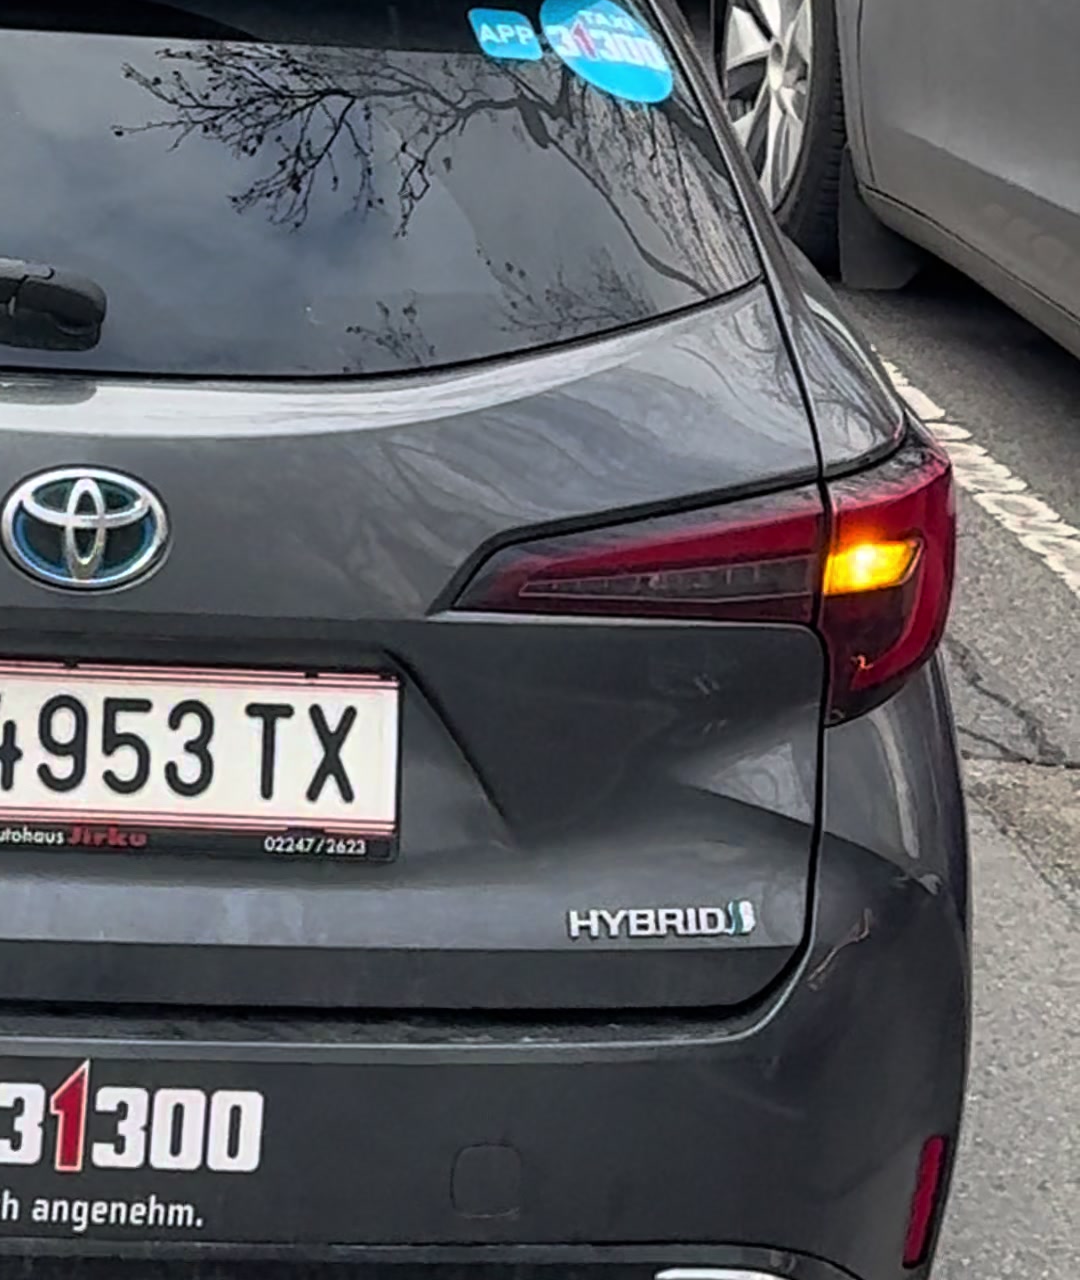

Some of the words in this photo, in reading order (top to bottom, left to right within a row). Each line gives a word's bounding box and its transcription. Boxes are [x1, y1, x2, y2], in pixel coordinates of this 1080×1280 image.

[479, 23, 534, 45] APP
[245, 702, 358, 802] TX
[70, 825, 147, 848] Jirku
[264, 835, 366, 856] 02247/2623
[568, 907, 727, 937] HYBRID
[32, 1195, 204, 1233] angenehm.
